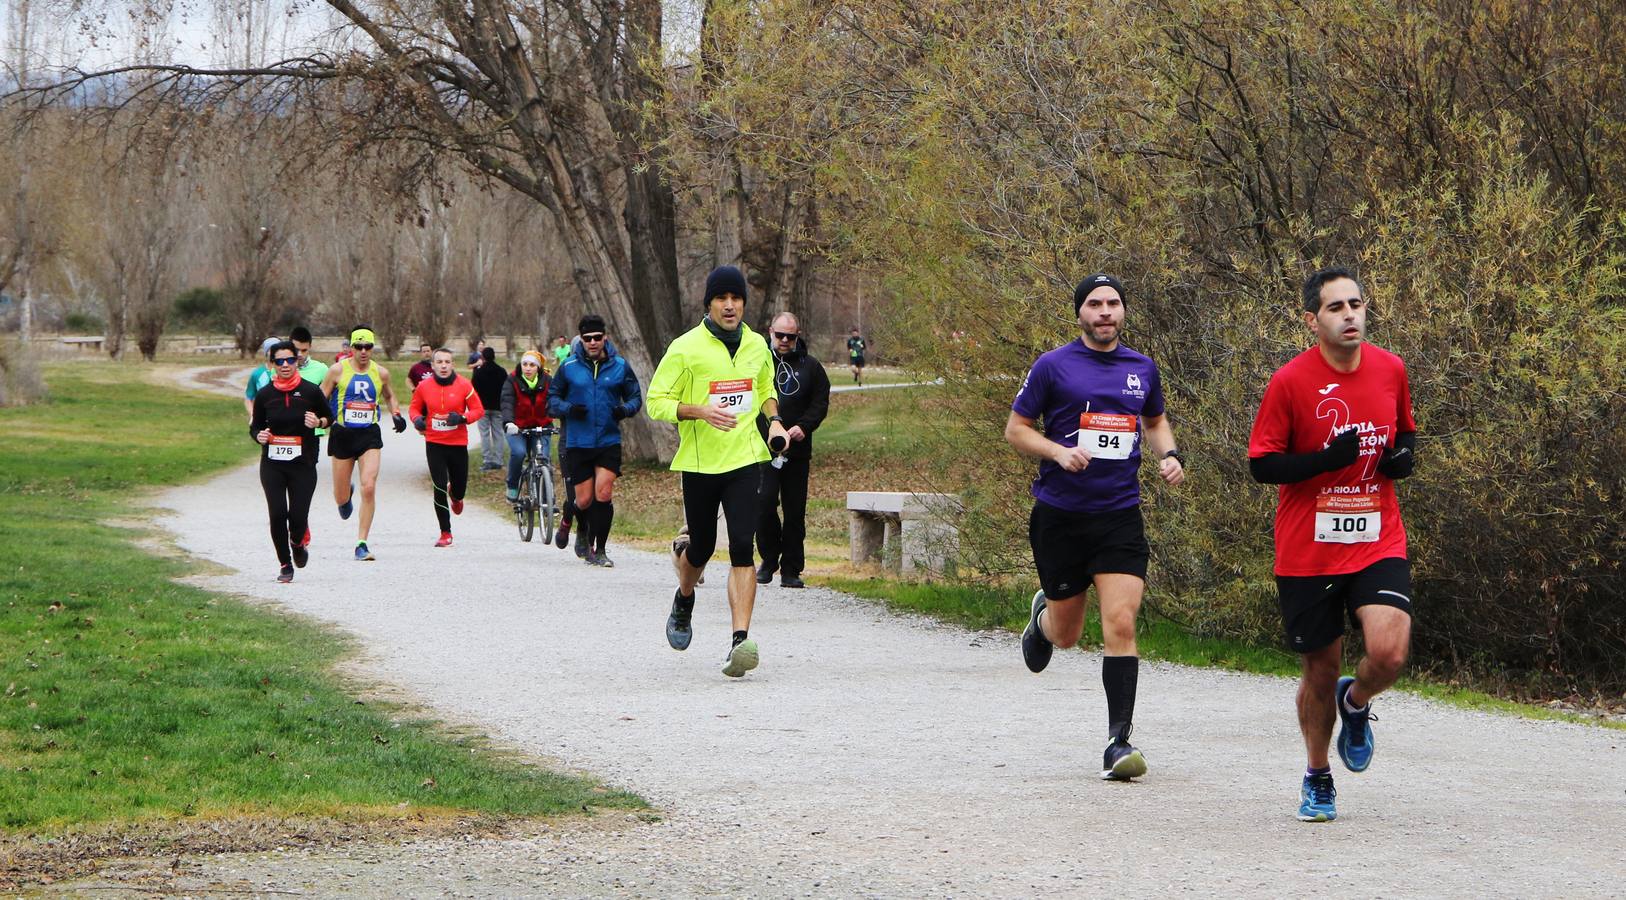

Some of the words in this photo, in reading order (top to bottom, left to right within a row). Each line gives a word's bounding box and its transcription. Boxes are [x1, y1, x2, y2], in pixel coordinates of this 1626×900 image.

[354, 381, 373, 402] R
[720, 395, 743, 406] 297
[351, 411, 368, 419] 304
[1098, 435, 1119, 448] 94
[276, 447, 293, 455] 176
[1334, 486, 1360, 494] RIOJA
[1332, 517, 1367, 533] 100
